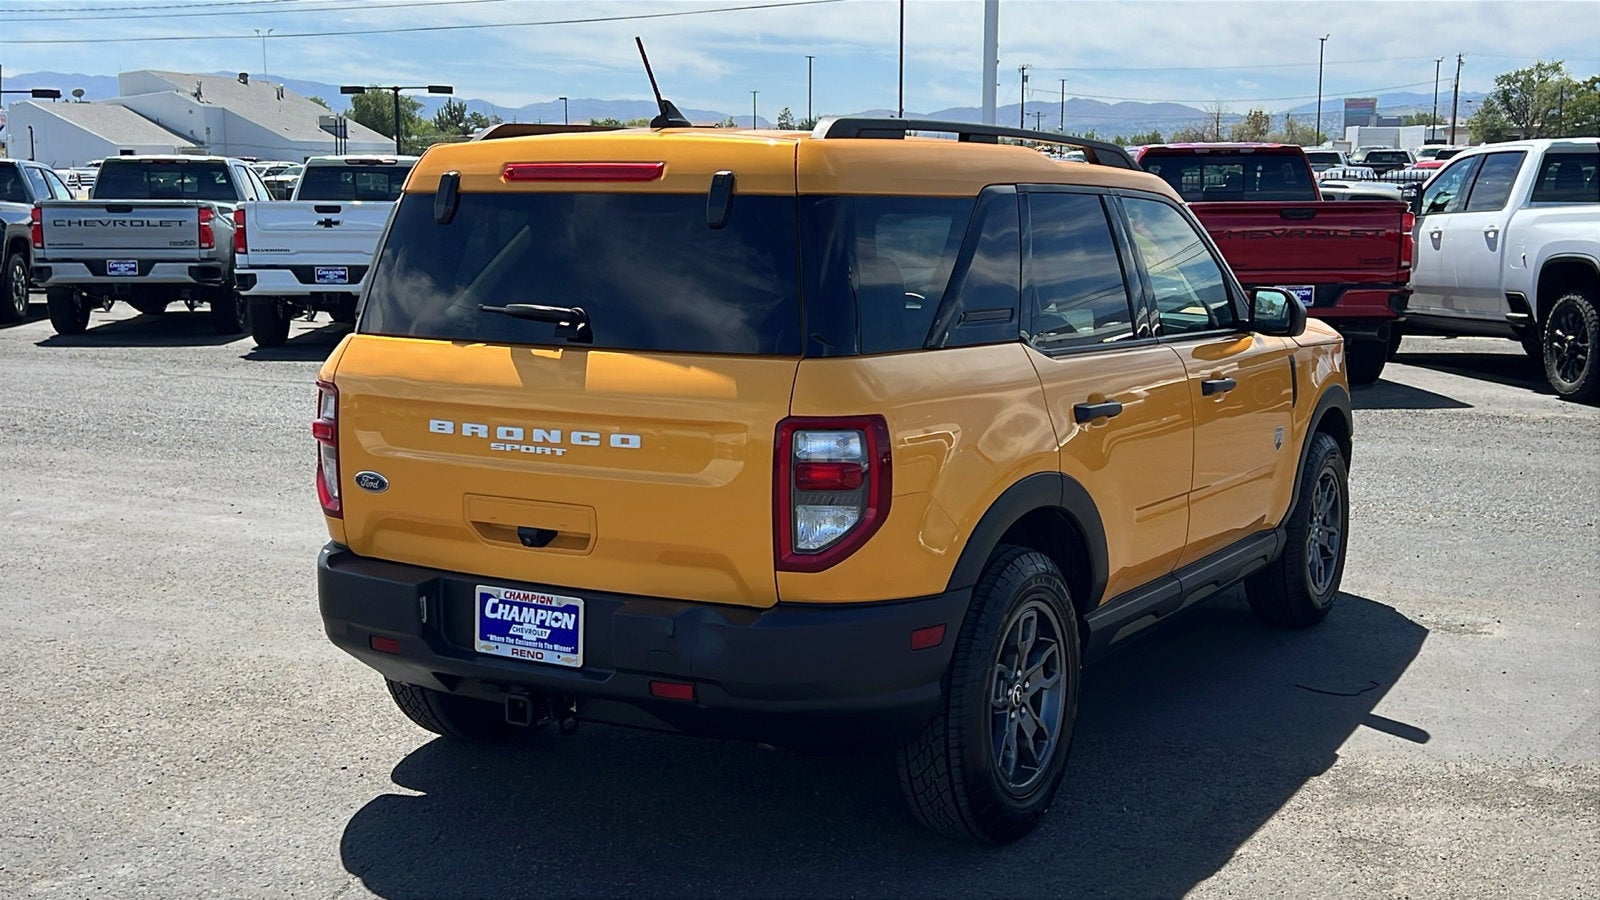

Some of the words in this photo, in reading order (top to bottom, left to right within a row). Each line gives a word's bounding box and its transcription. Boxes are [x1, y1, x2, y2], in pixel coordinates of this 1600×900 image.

[53, 219, 187, 228] CHEVROLET
[429, 419, 641, 448] BRONCO
[490, 442, 567, 455] SPORT
[360, 475, 380, 489] Ford
[503, 590, 554, 605] CHAMPION
[484, 597, 576, 630] CHAMPION
[512, 626, 548, 638] CHEVROLET
[505, 636, 515, 644] The
[515, 637, 538, 648] Customer
[544, 642, 553, 650] The
[511, 648, 544, 660] RENO
